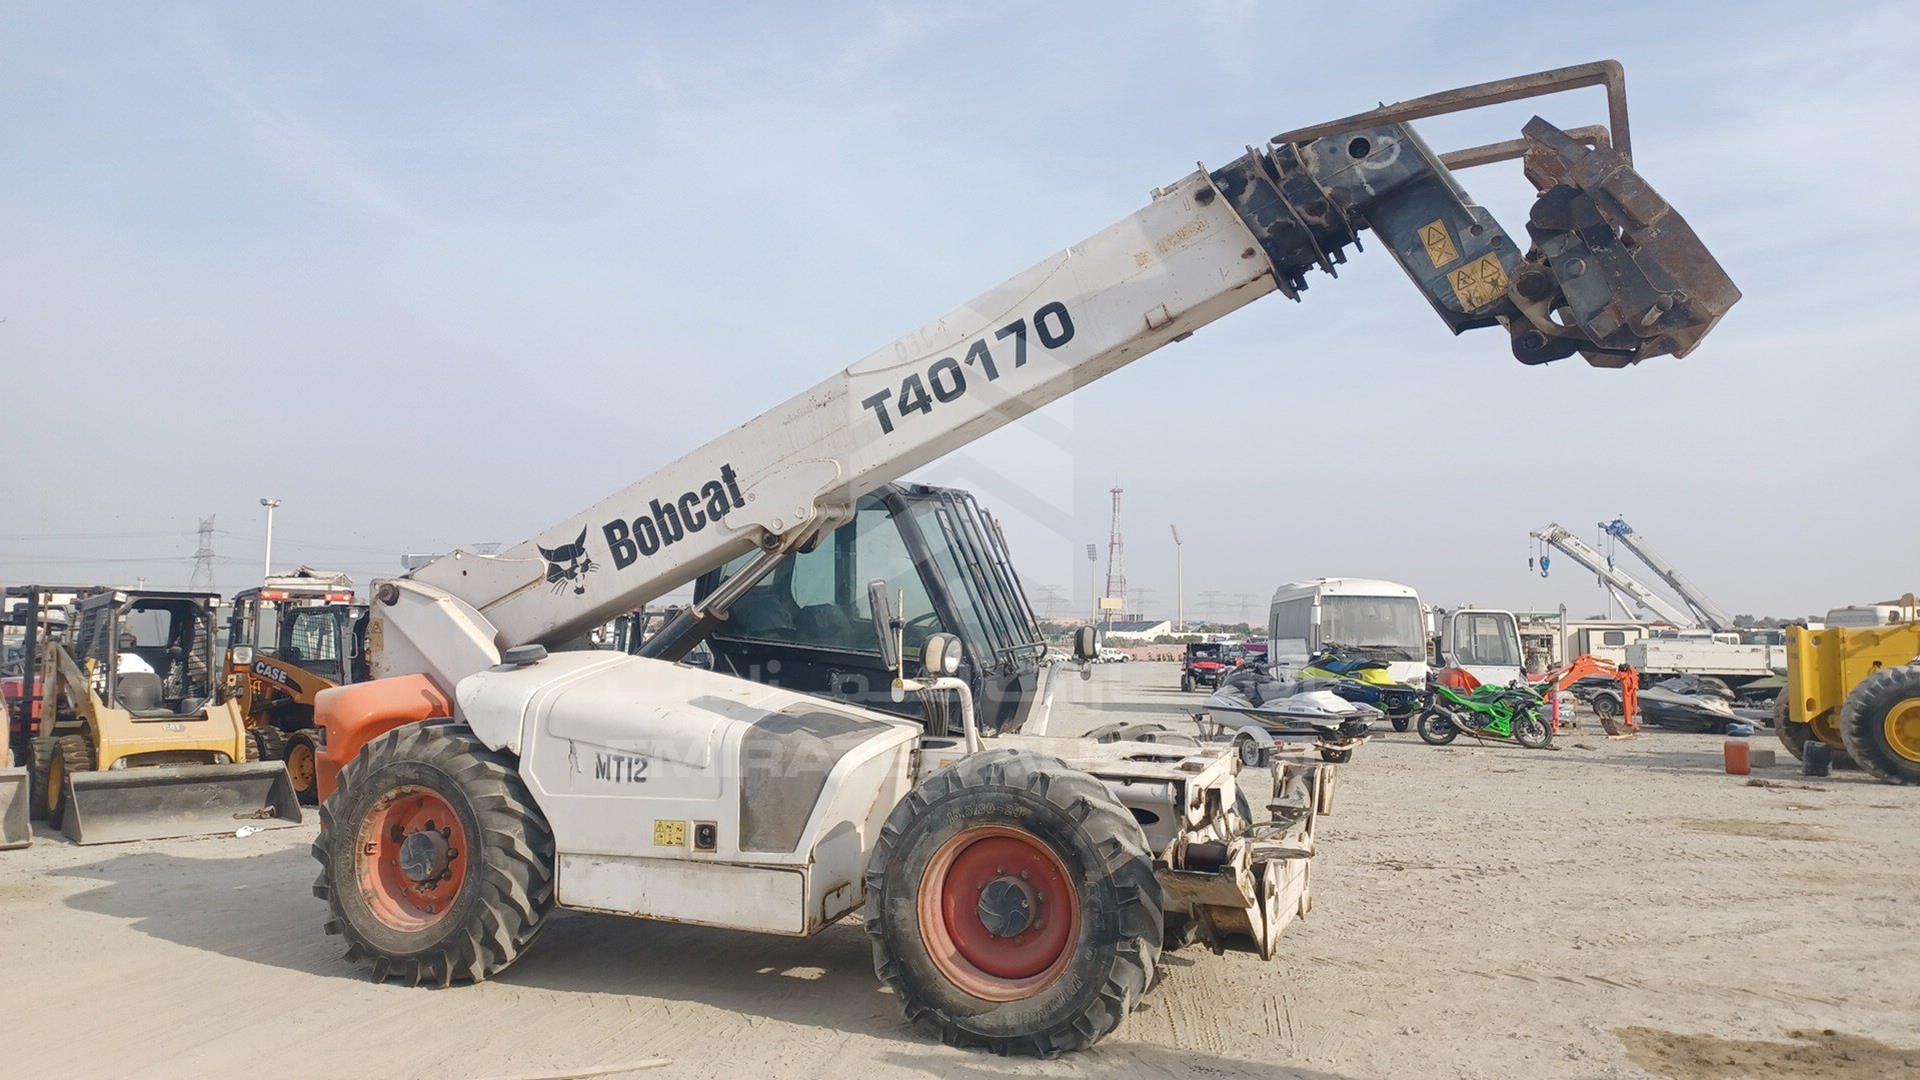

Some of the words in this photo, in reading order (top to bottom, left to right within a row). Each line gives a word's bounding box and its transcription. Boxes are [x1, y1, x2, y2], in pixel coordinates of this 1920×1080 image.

[861, 301, 1075, 435] T40170
[602, 463, 746, 571] Bobcat
[255, 661, 288, 683] CASE
[595, 753, 648, 783] MT12
